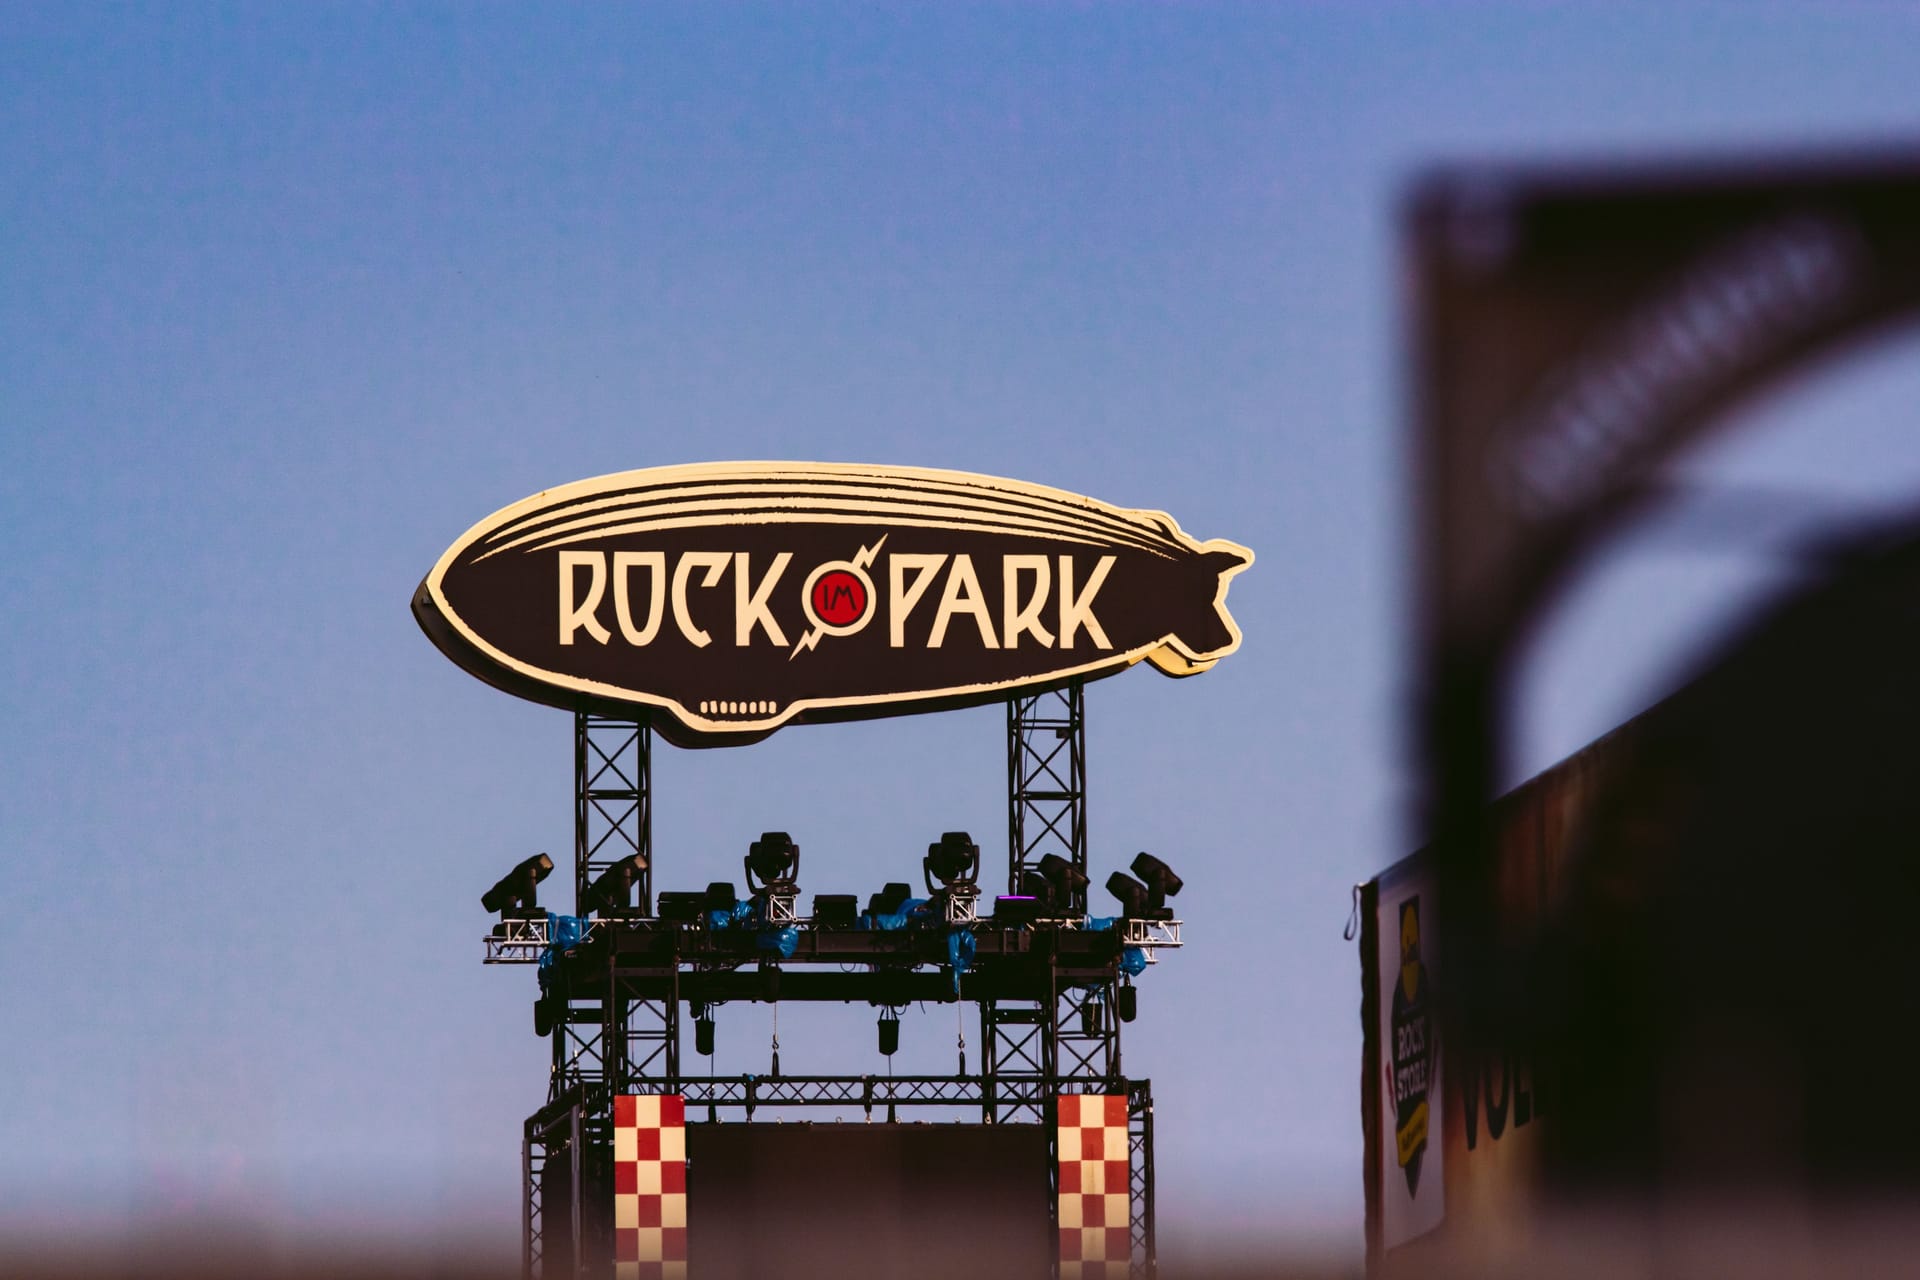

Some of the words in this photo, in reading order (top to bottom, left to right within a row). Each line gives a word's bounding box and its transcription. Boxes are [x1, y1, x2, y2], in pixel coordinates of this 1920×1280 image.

[559, 551, 794, 648] ROCK
[823, 584, 857, 611] IM
[889, 553, 1116, 650] PARK
[1397, 1058, 1427, 1102] STORE
